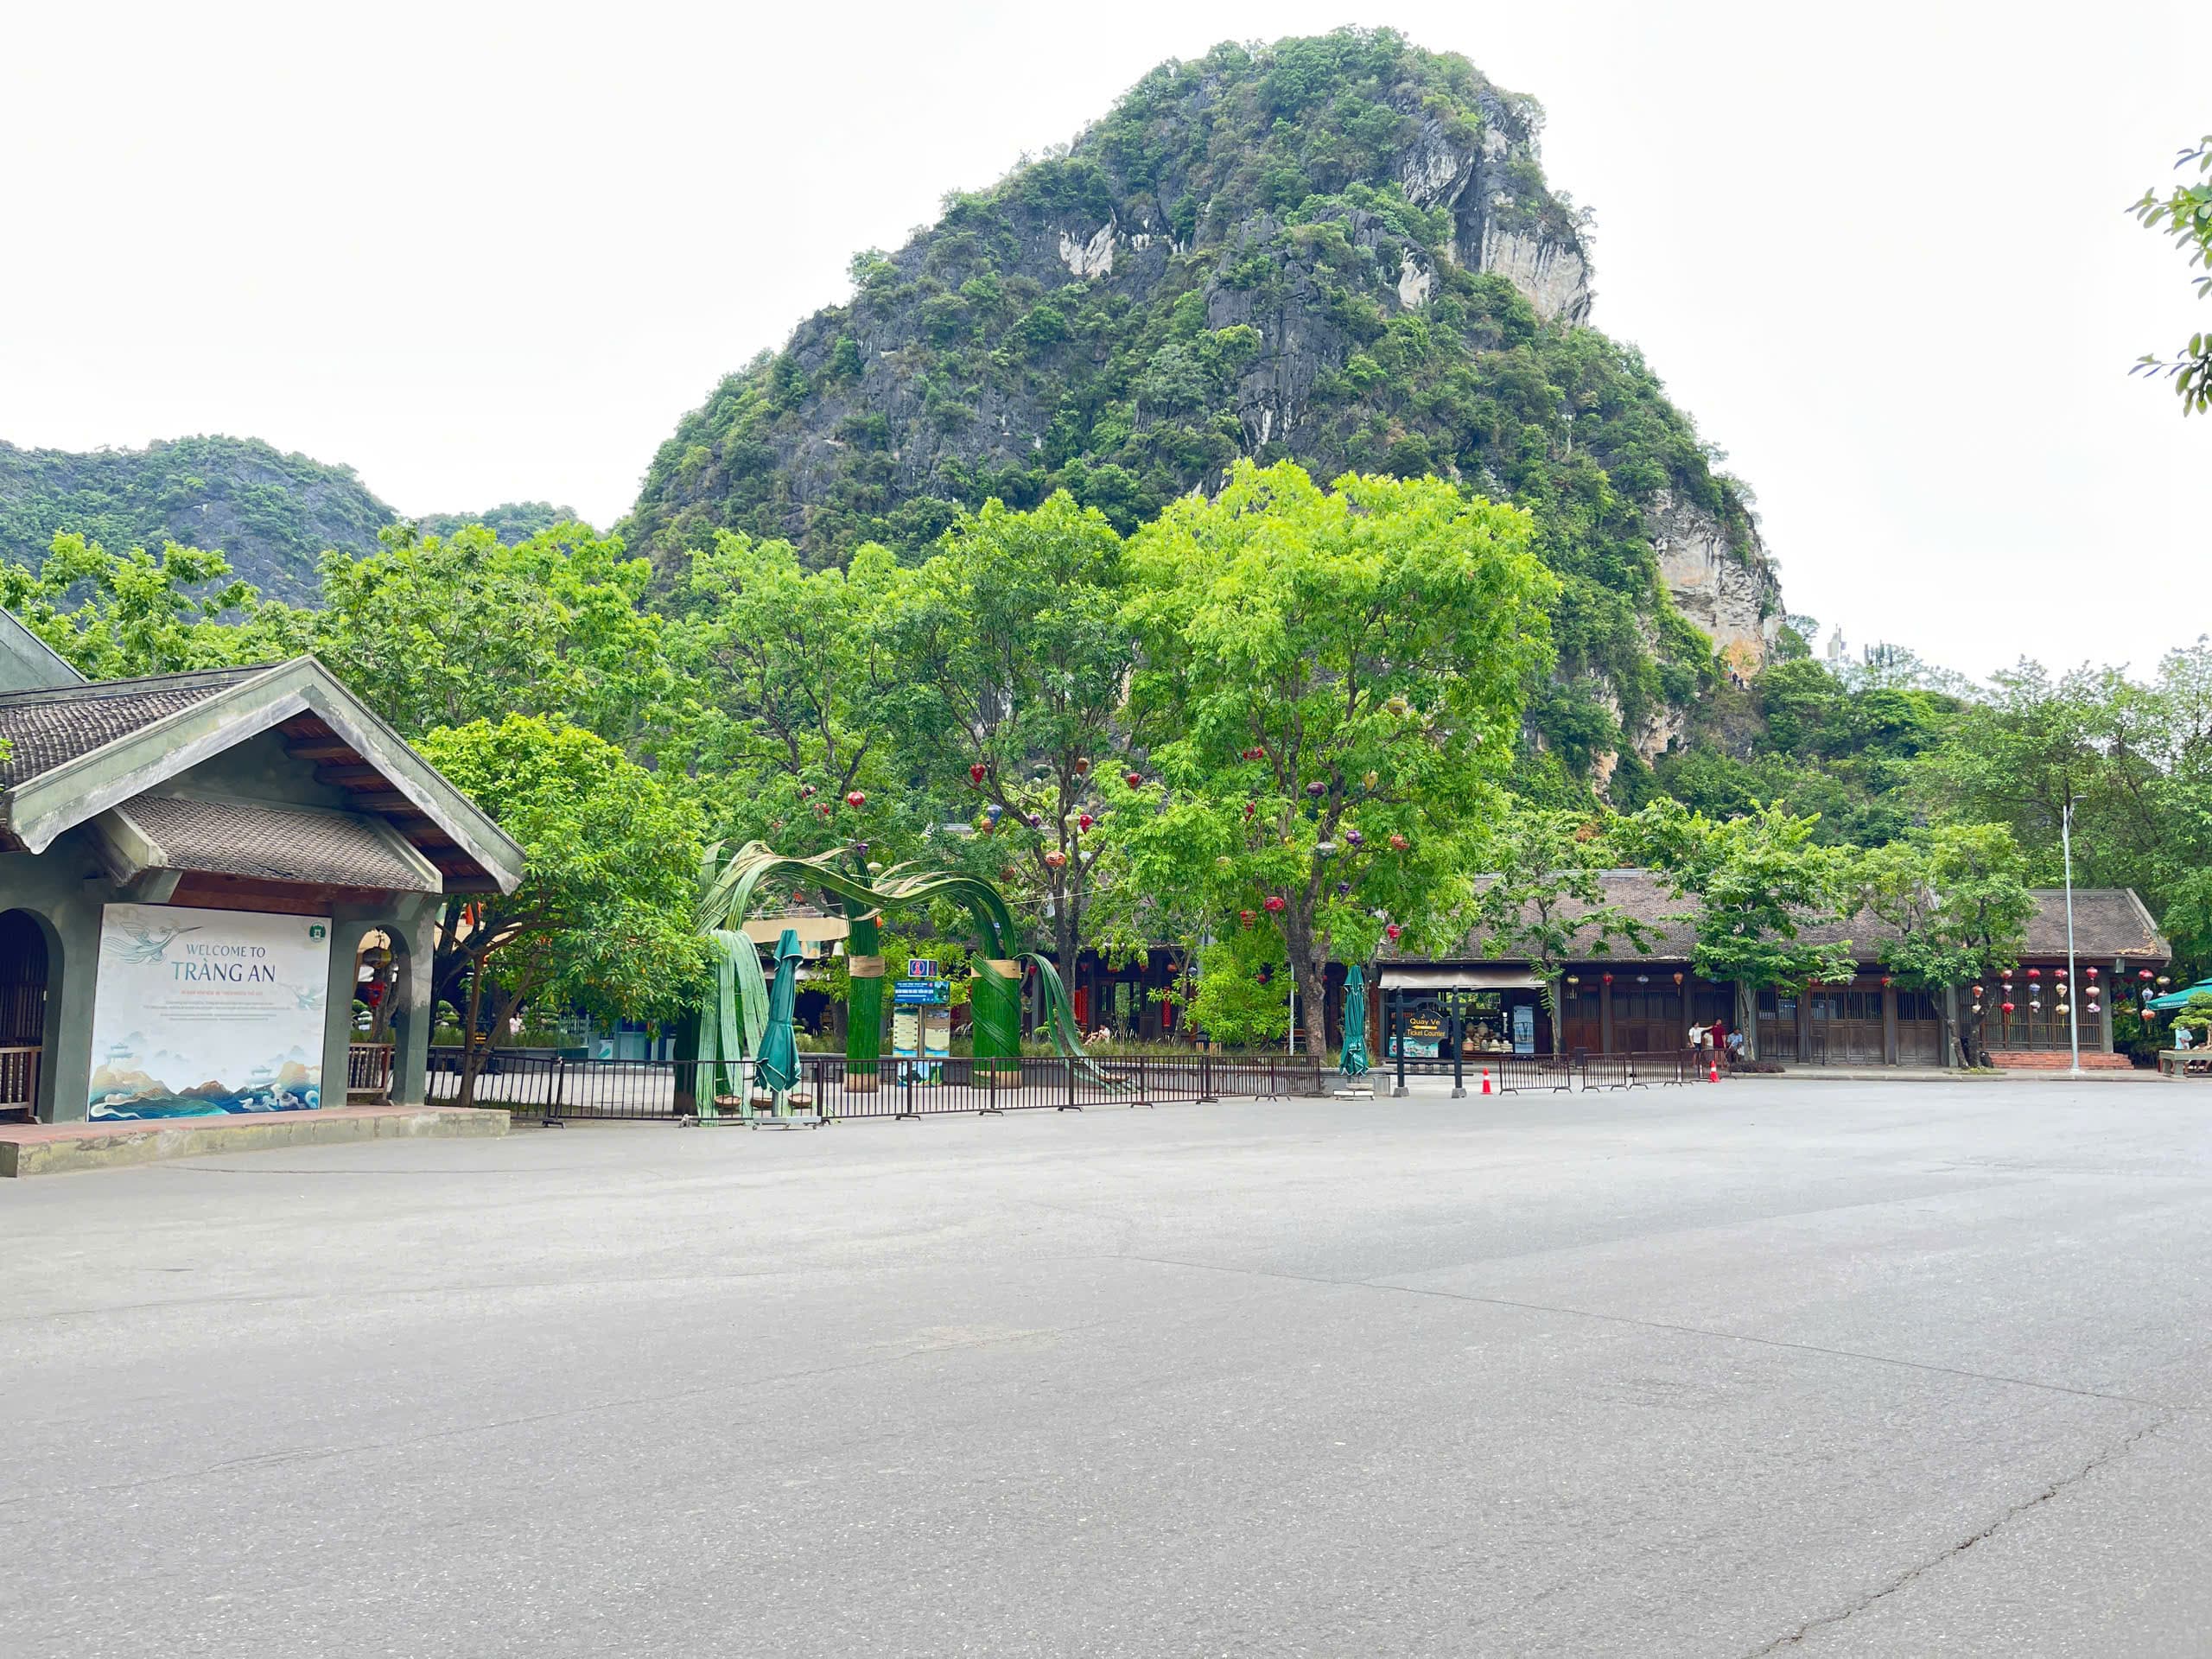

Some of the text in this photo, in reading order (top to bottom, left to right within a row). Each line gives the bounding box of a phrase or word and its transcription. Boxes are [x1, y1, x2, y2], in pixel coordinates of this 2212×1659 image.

[186, 944, 266, 958] WELCOME TO
[171, 957, 276, 982] TRÀNG AN
